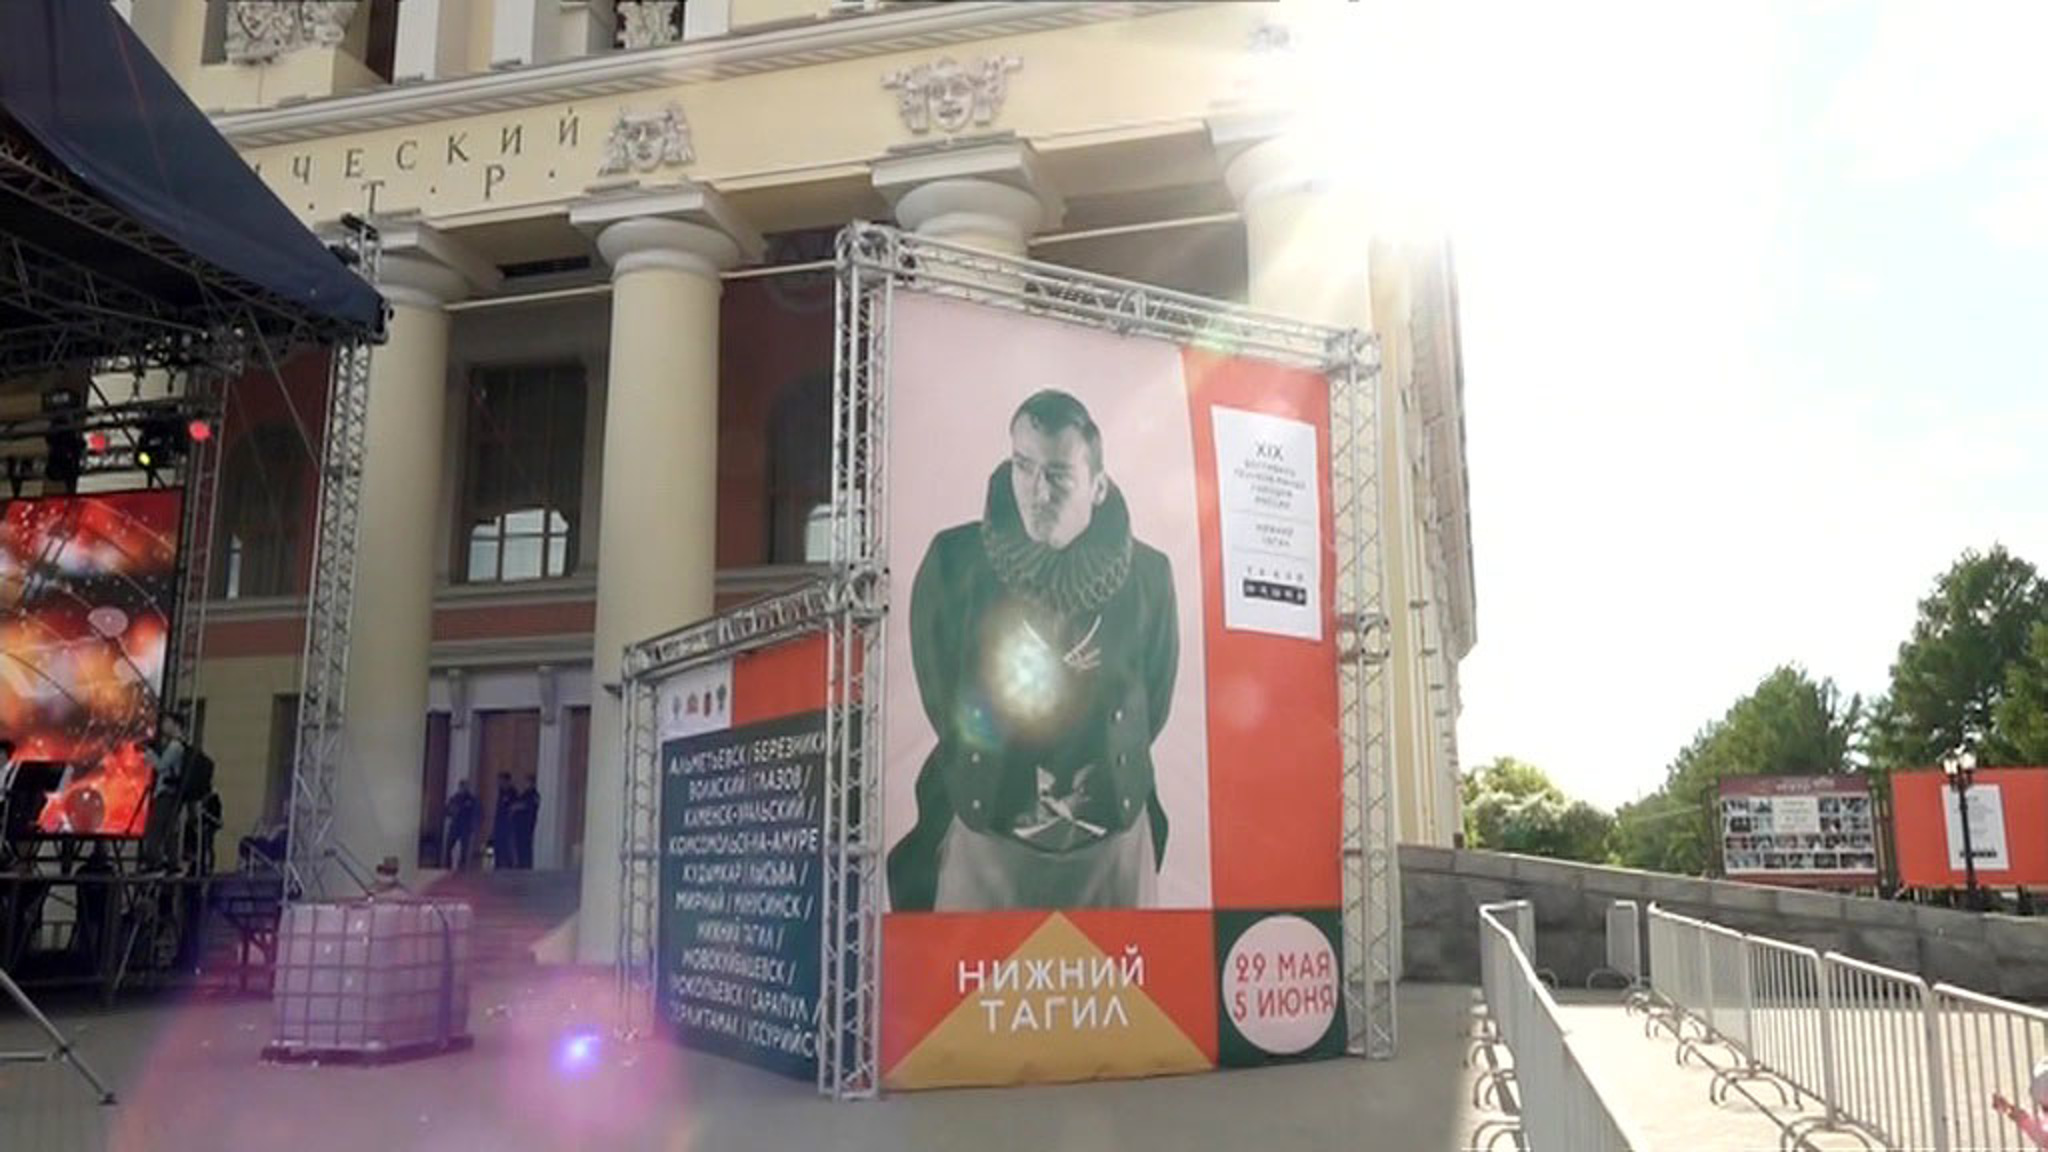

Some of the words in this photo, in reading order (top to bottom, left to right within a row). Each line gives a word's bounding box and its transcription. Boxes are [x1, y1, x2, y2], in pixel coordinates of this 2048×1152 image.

[254, 107, 579, 184] ЧЕСКИЙ
[1255, 440, 1284, 461] XIX
[956, 944, 1146, 993] НИЖНИЙ
[1235, 954, 1266, 983] 29
[1277, 950, 1332, 980] МАЯ
[980, 994, 1129, 1033] ТАГИЛ
[1233, 993, 1246, 1023] 5
[1258, 984, 1335, 1018] ИЮНЯ
